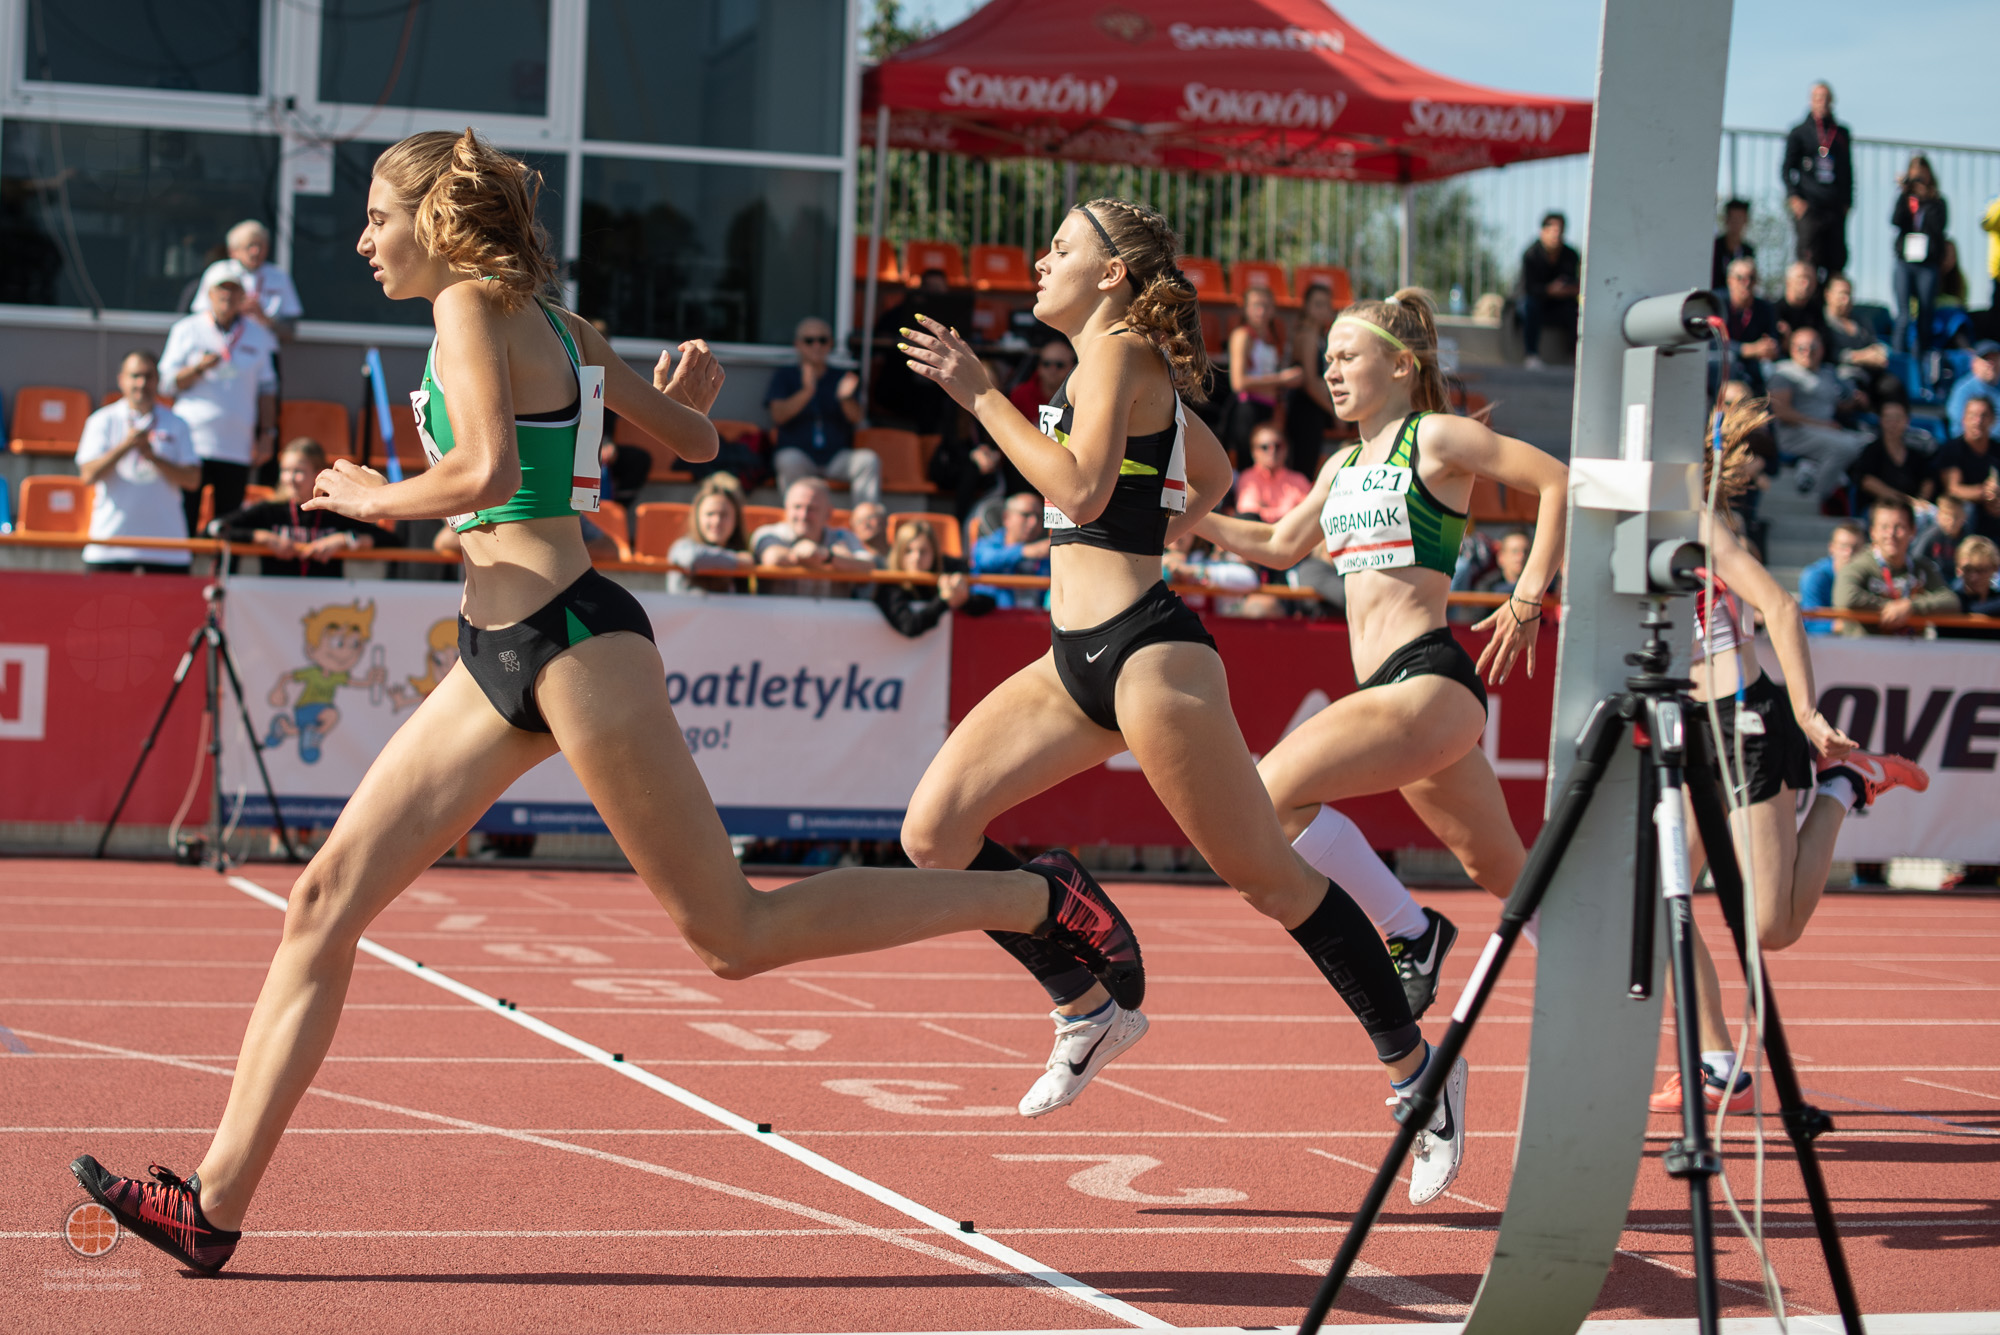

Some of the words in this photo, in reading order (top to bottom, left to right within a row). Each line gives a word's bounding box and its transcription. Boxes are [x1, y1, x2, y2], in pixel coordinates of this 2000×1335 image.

[1362, 469, 1402, 492] 621
[1325, 506, 1402, 536] URBANIAK
[1371, 553, 1394, 566] 2019
[1780, 684, 2000, 771] OVE
